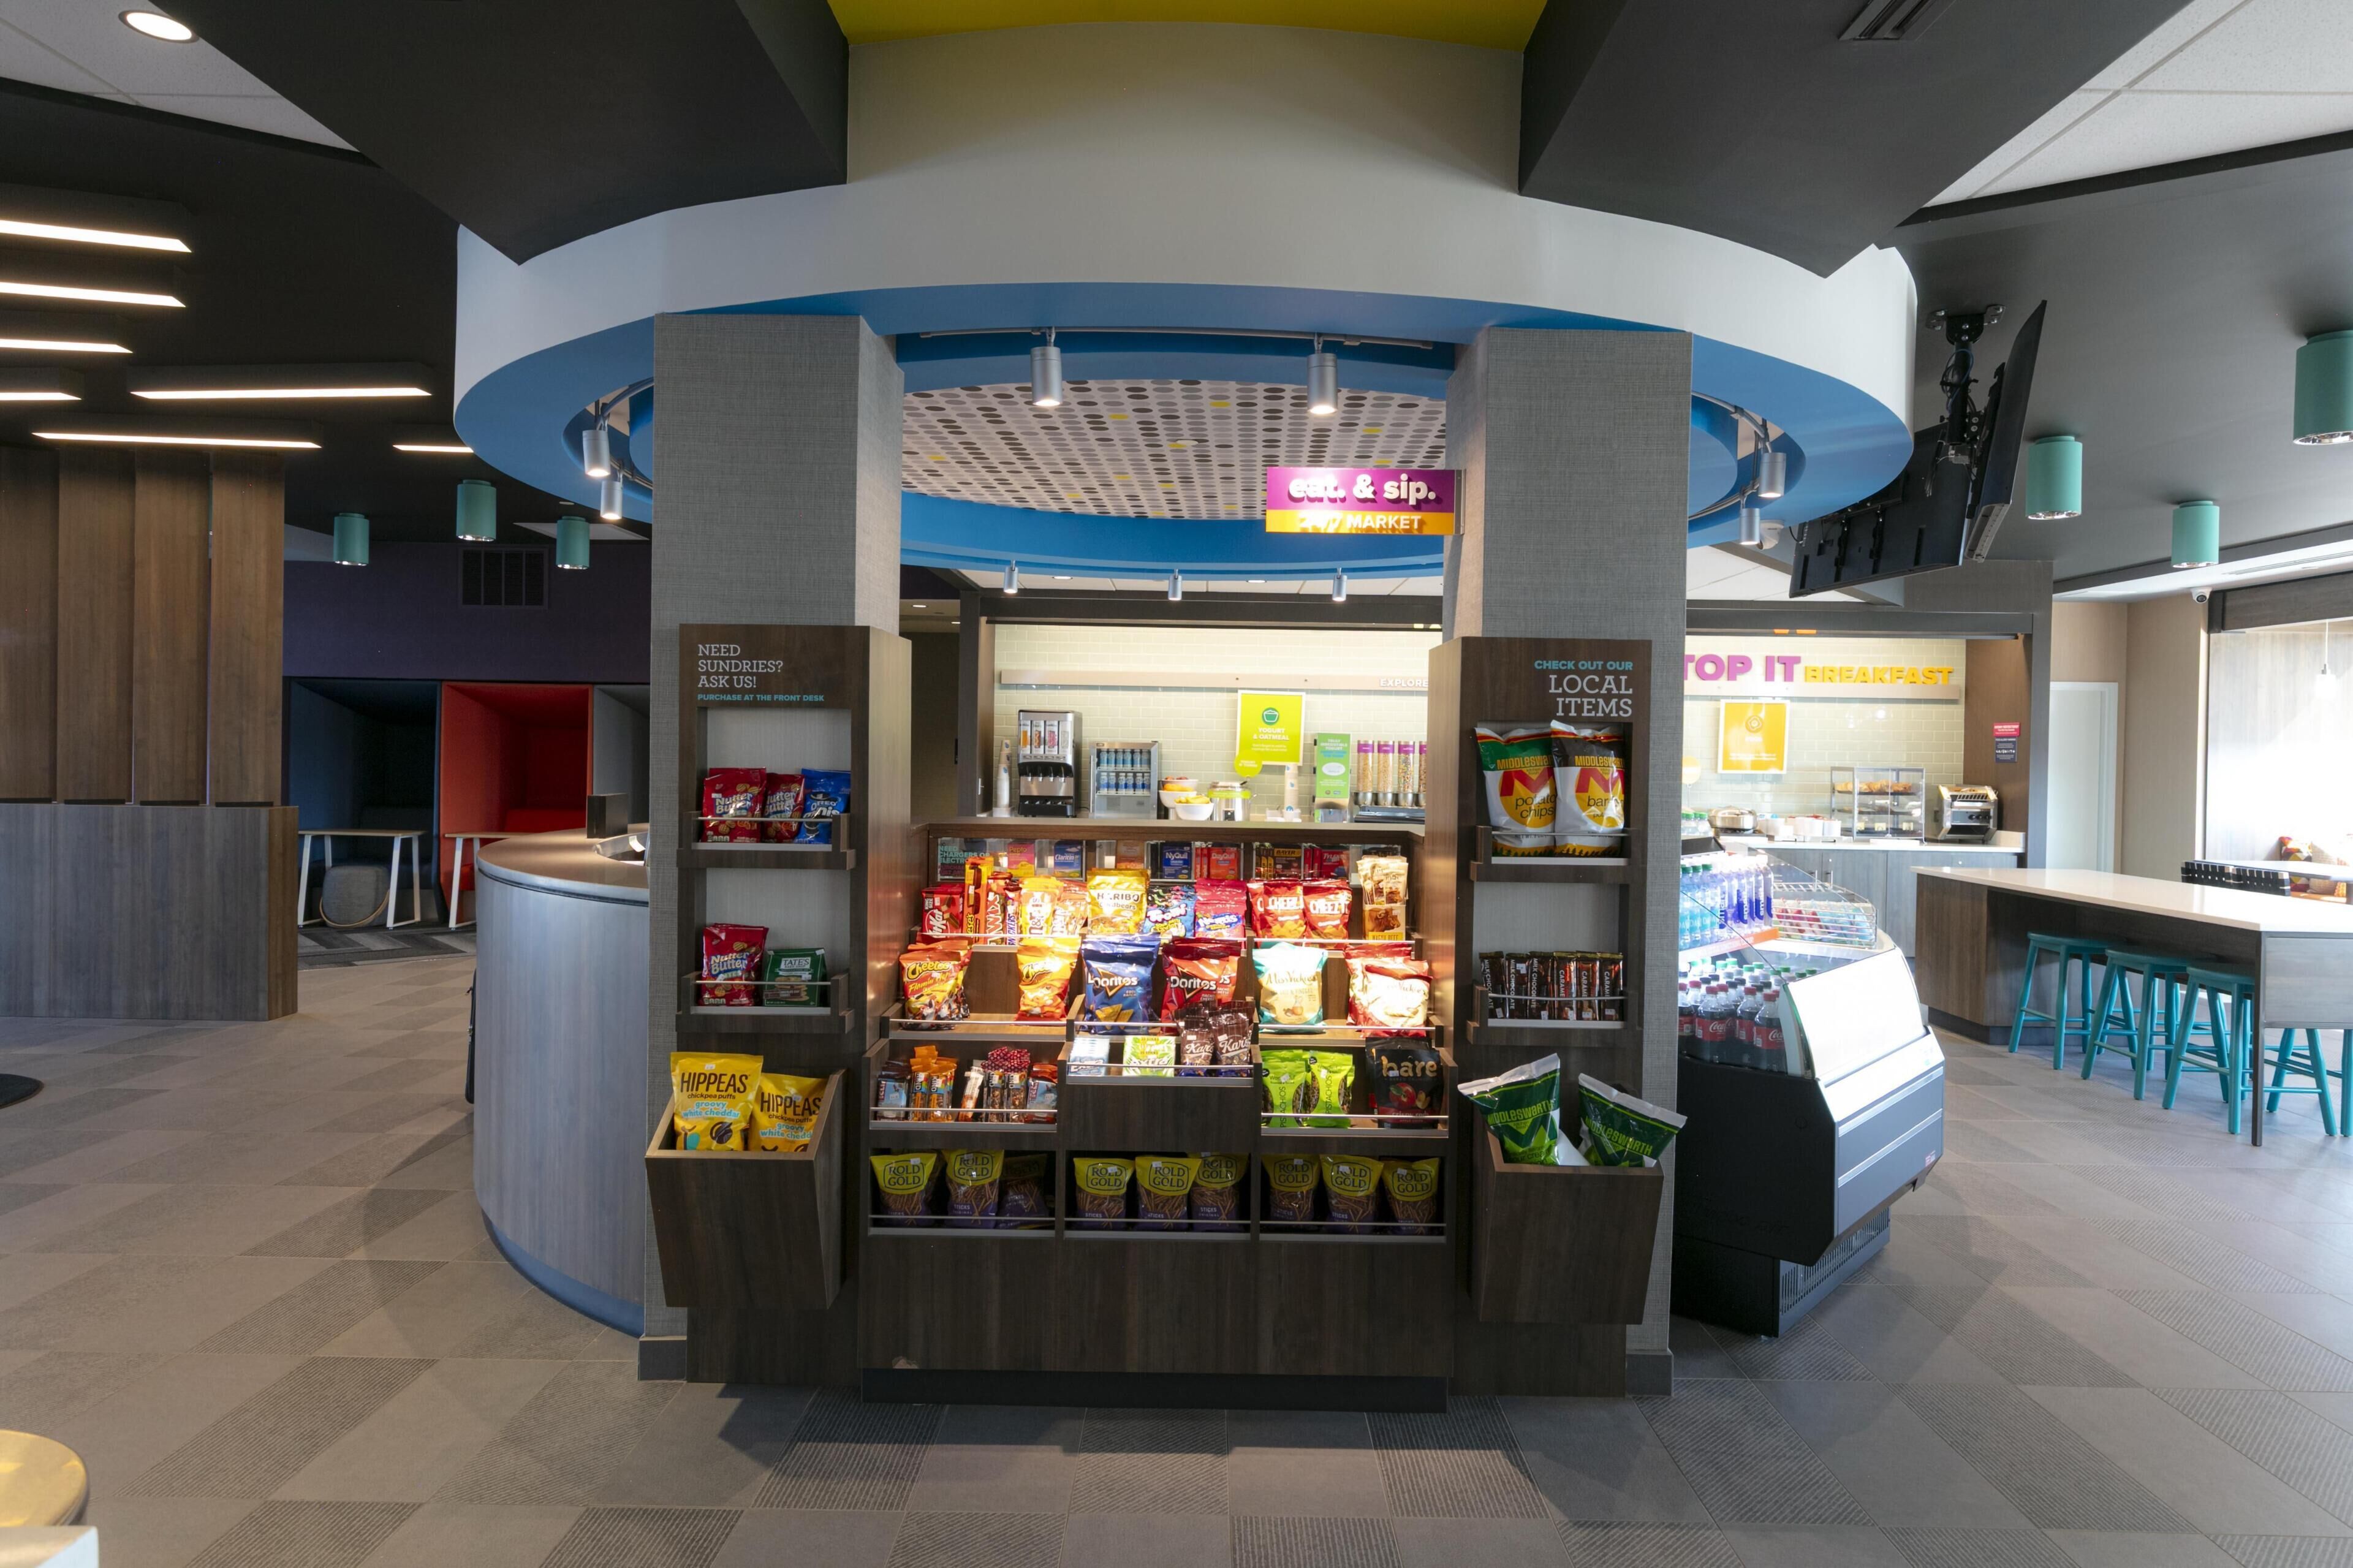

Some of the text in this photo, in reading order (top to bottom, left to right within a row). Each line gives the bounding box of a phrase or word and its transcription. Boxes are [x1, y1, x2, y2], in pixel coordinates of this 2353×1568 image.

[1289, 473, 1436, 506] eat. & sip.
[1347, 515, 1422, 529] MARKET
[697, 644, 741, 656] NEED
[697, 660, 784, 673] SUNDRIES?
[1534, 660, 1633, 670] CHECK OUT OUR
[1765, 656, 1802, 682] IT
[1805, 665, 1954, 685] BREAKFAST
[697, 676, 757, 688] ASK US!
[1549, 675, 1633, 694] LOCAL
[1556, 698, 1632, 717] ITEMS
[716, 793, 752, 806] Nutter
[716, 800, 751, 814] Buer
[1520, 805, 1555, 819] chips
[1097, 893, 1140, 903] HRIBO
[1099, 902, 1136, 911] Gdbears
[711, 952, 749, 964] Nutter
[711, 959, 747, 975] Butter
[1170, 975, 1217, 990] Doritos
[1485, 974, 1495, 1009] CHOCATE
[1381, 1055, 1438, 1077] bare
[680, 1072, 749, 1094] HIPPEAS
[695, 1100, 727, 1109] groovy
[760, 1093, 821, 1116] HIPPEAS
[683, 1109, 740, 1118] white cheddar
[768, 1113, 795, 1123] chickpea
[776, 1122, 805, 1132] groovy
[760, 1129, 785, 1138] white
[959, 1156, 990, 1167] ROLD
[889, 1165, 920, 1175] ROLD
[1091, 1167, 1123, 1177] ROLD
[1154, 1167, 1186, 1177] ROLD
[1278, 1164, 1309, 1173] ROLD
[1201, 1169, 1234, 1180] GOLD
[1278, 1173, 1309, 1184] GOLD
[1397, 1172, 1428, 1182] ROLD
[888, 1176, 920, 1187] GOLD
[1090, 1178, 1123, 1187] GOLD
[1153, 1177, 1185, 1188] GOLD
[1335, 1177, 1367, 1188] GOLD
[1397, 1183, 1429, 1194] GOLD
